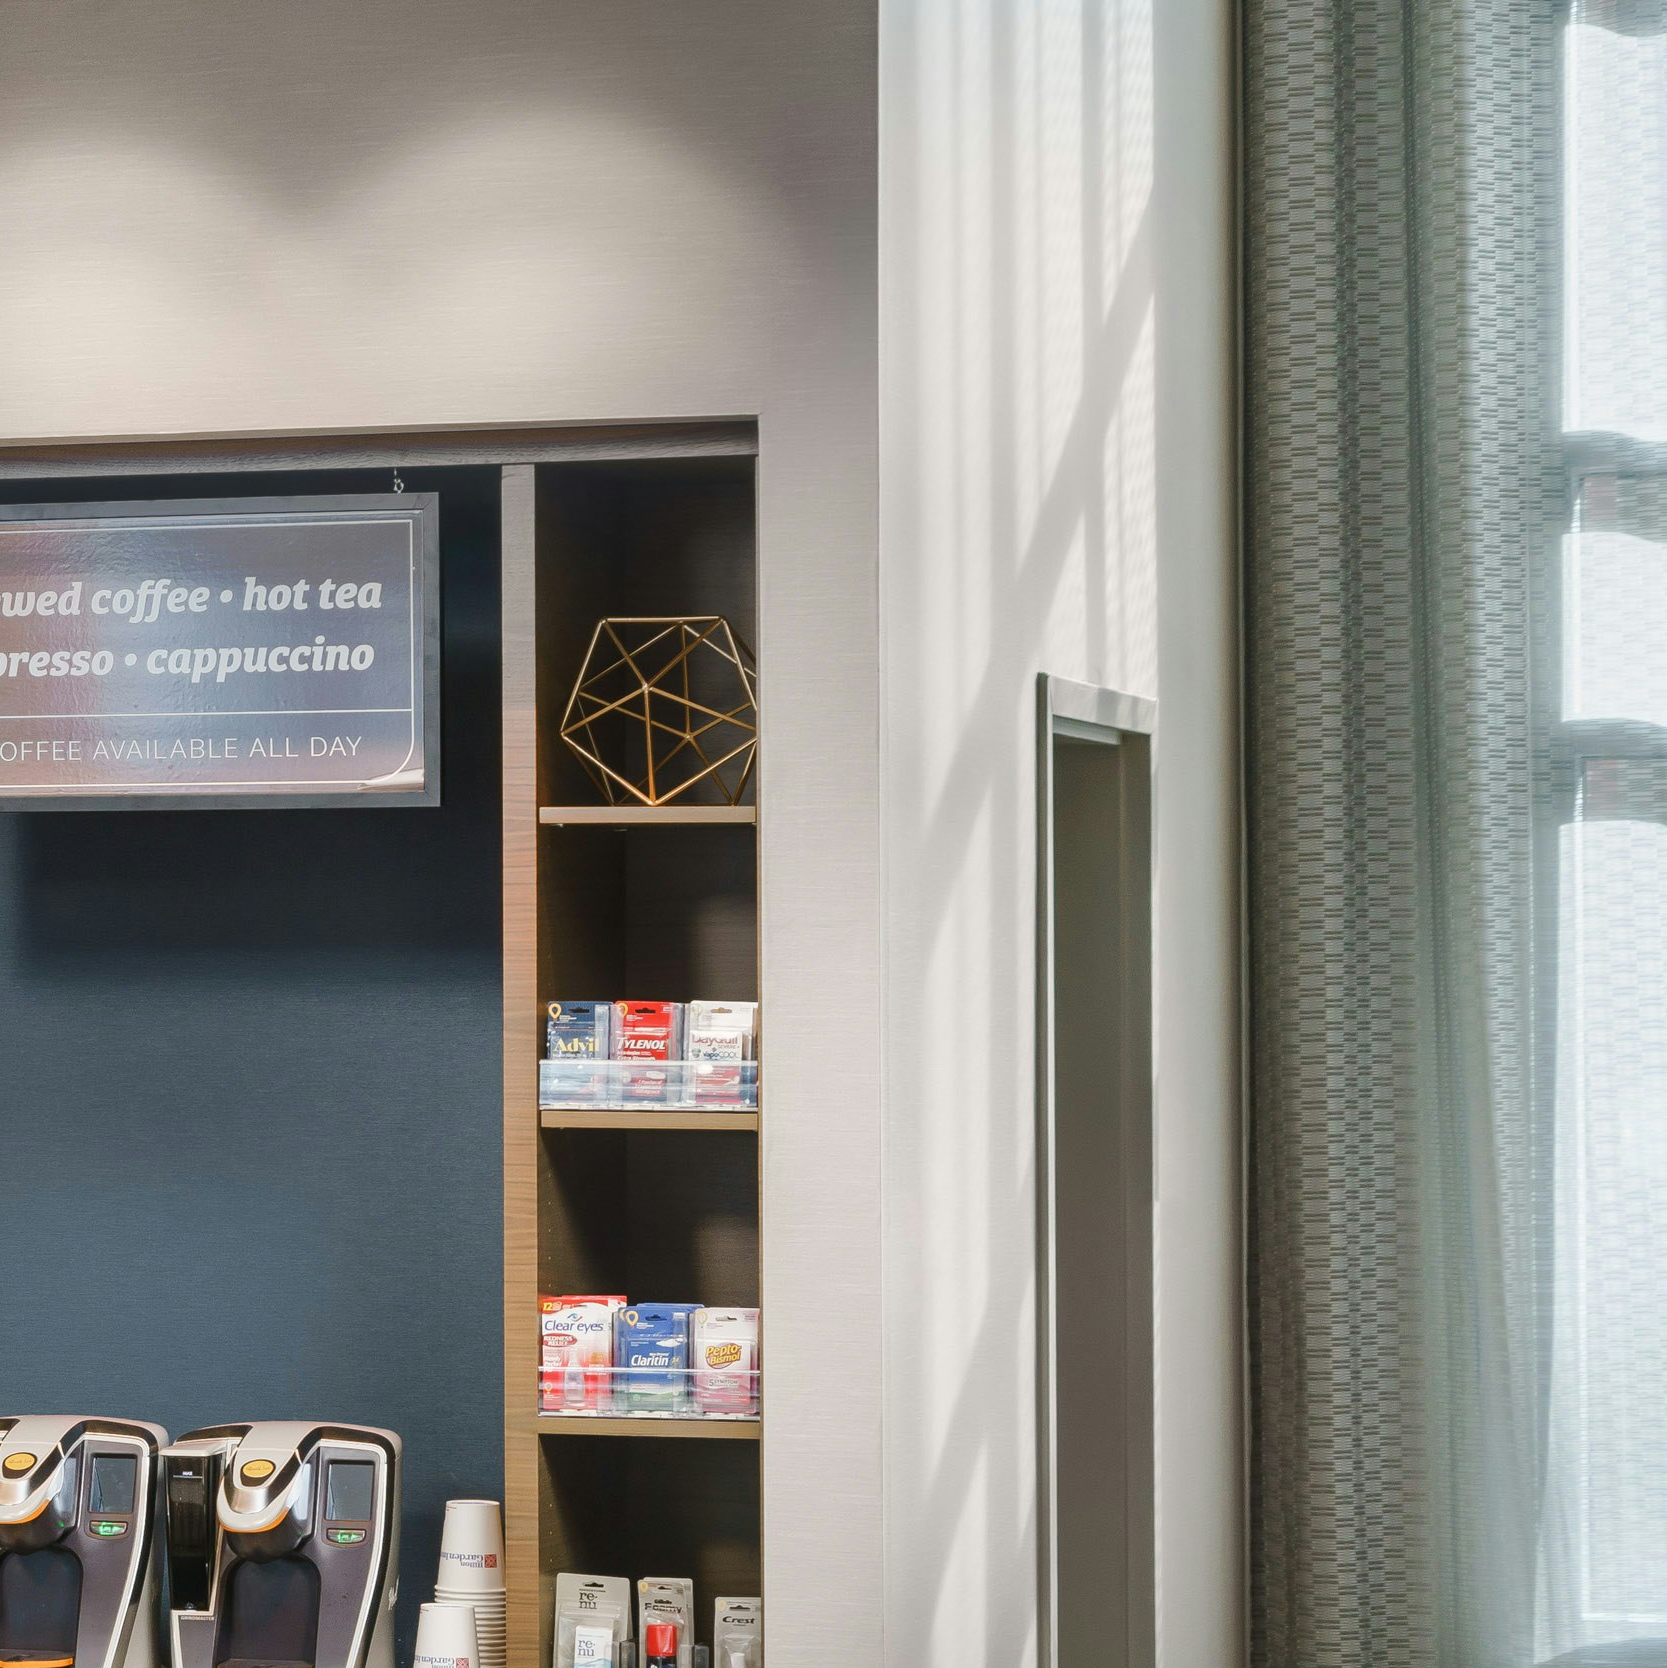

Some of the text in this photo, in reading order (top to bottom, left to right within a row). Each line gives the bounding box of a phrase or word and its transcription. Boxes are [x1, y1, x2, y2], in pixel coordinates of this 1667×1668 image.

[91, 580, 209, 624] coffee
[243, 577, 309, 612] hot
[319, 580, 381, 609] tea
[147, 636, 374, 684] cappuccino
[93, 738, 238, 761] AVAILABLE
[250, 737, 298, 758] ALL
[310, 736, 362, 757] DAY
[554, 1036, 600, 1054] Advil
[616, 1036, 667, 1051] TYLENOL
[544, 1318, 604, 1334] Clear eyes
[705, 1343, 742, 1357] Pepto-
[630, 1354, 669, 1368] Claritin
[710, 1351, 741, 1366] Bismol
[579, 1601, 597, 1609] nu
[644, 1603, 683, 1614] Foamy
[722, 1615, 755, 1625] Crest
[578, 1648, 595, 1656] nu
